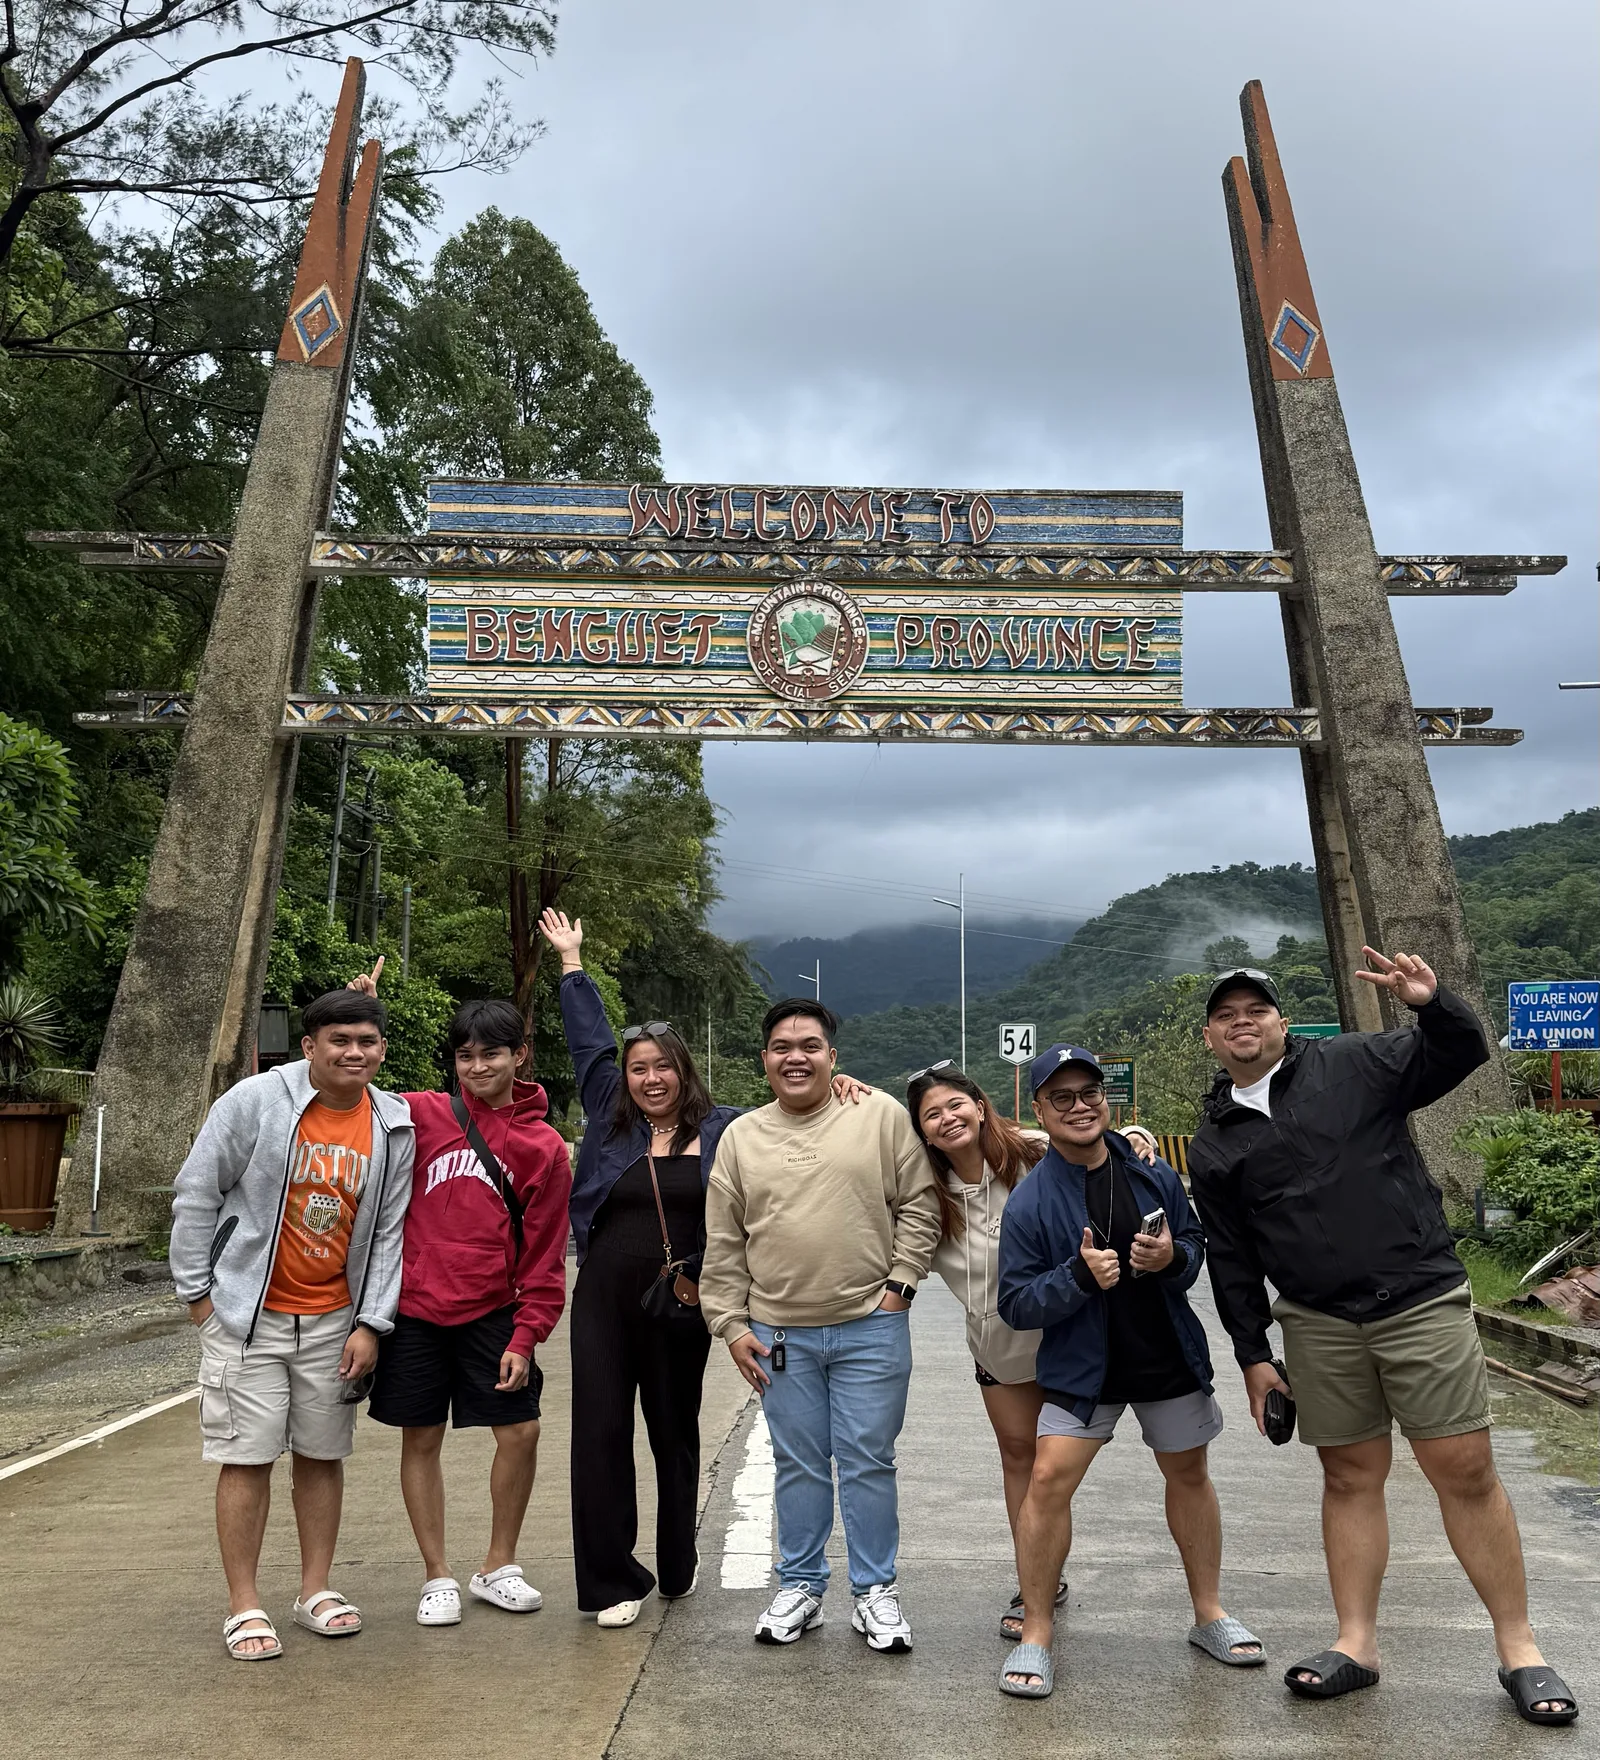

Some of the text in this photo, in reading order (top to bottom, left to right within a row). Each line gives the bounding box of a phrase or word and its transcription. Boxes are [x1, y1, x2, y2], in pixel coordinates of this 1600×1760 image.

[628, 483, 996, 545] WELCOME TO
[751, 582, 866, 638] MOUNTAIN PROVINCE
[464, 606, 1157, 672] BENGUET PROVINCE
[758, 660, 860, 698] OFFICIAL SEAL
[1513, 992, 1598, 1005] YOU ARE NOW
[1529, 1010, 1582, 1022] LEAVING
[1003, 1028, 1032, 1056] 54
[1516, 1027, 1595, 1040] LA UNION
[289, 1140, 370, 1199] OSTON
[424, 1148, 516, 1200] INDIA
[309, 1207, 339, 1231] 97
